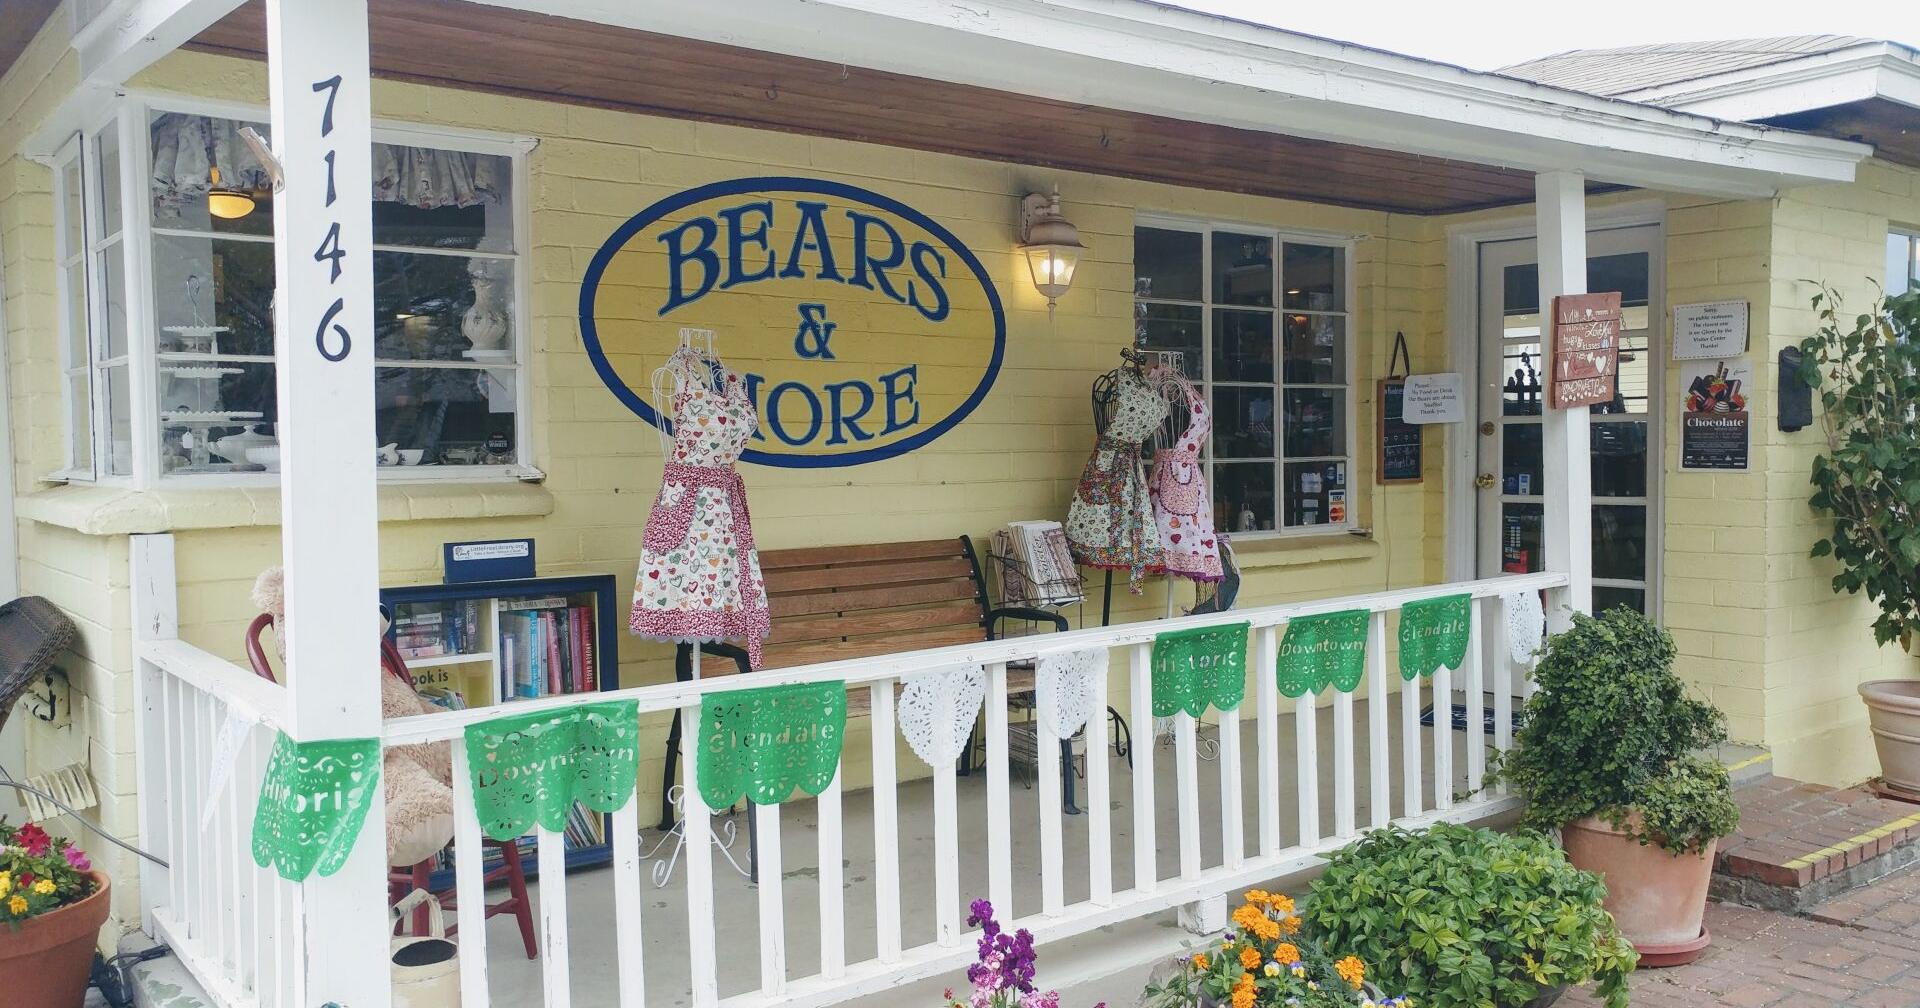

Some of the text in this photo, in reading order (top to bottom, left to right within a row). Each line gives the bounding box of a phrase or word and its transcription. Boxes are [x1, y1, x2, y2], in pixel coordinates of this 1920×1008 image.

[657, 200, 951, 323] BEARS
[794, 303, 836, 360] &
[1686, 417, 1745, 427] Chocolate
[1402, 619, 1464, 642] Glendale
[1281, 639, 1364, 657] Downtown
[1155, 651, 1238, 673] Historic
[410, 669, 448, 685] ook is
[709, 723, 835, 754] Glendale
